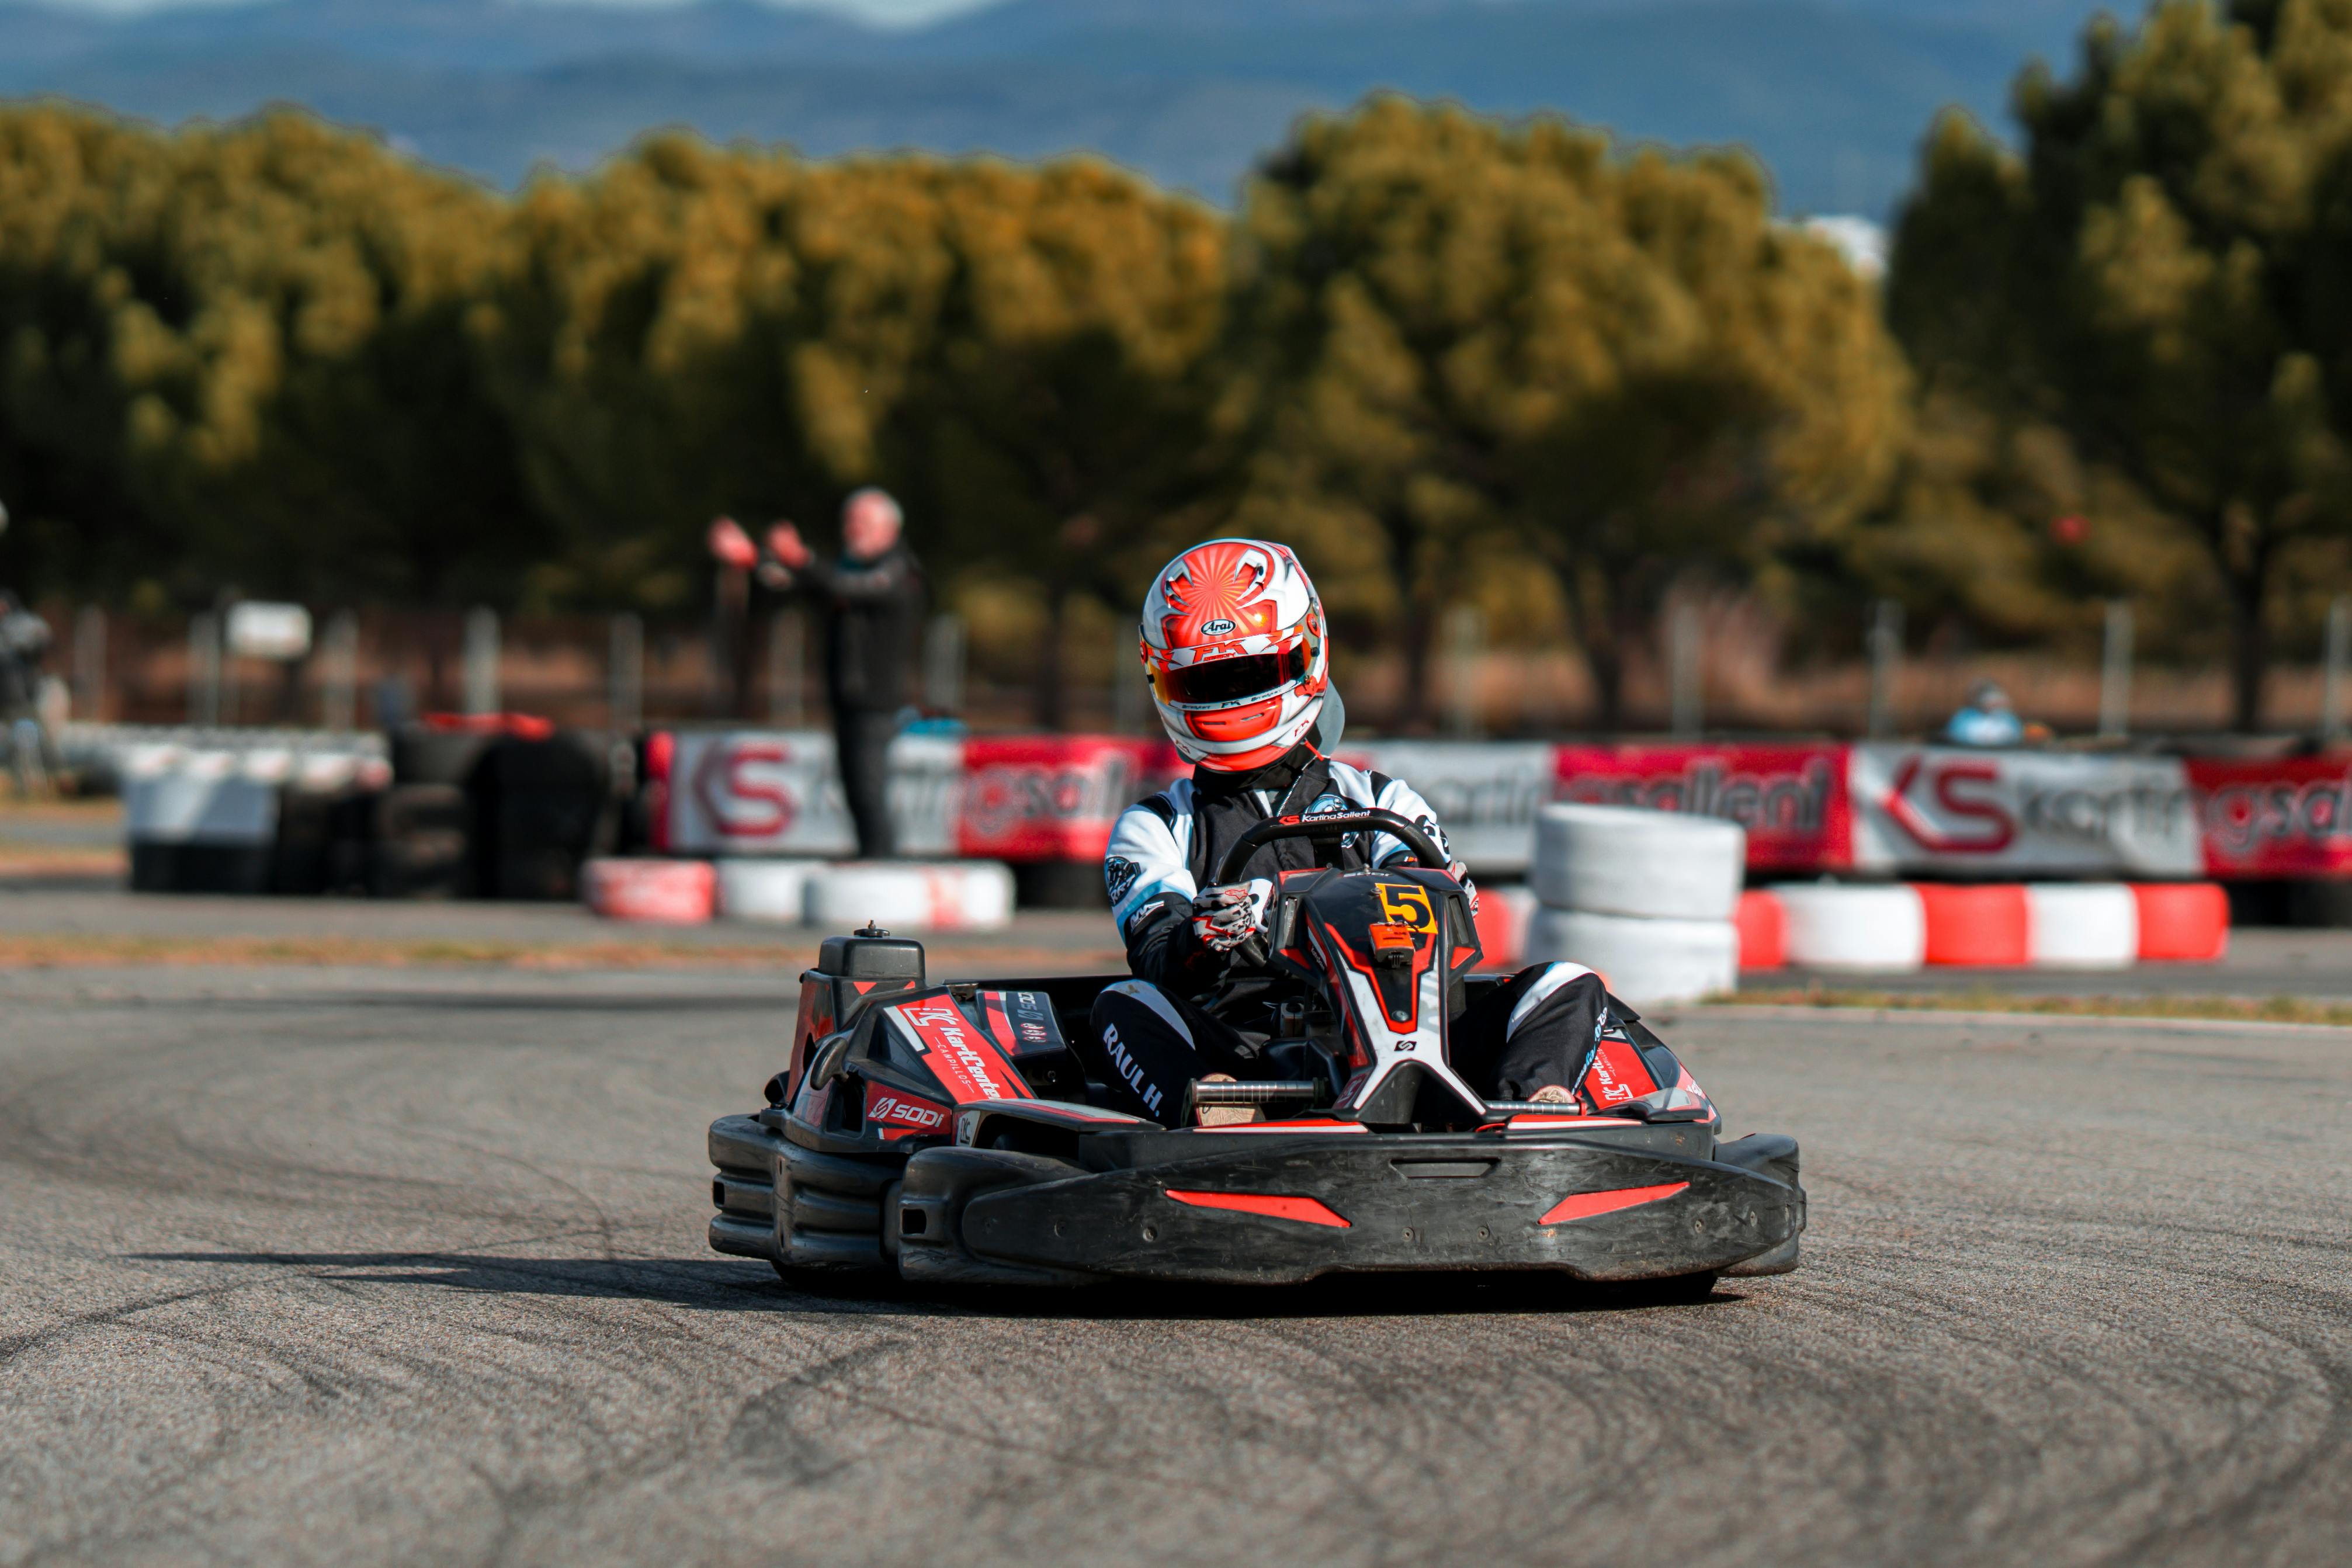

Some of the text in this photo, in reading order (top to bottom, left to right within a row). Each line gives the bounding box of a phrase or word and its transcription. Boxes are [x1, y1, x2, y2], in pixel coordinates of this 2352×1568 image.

[1203, 621, 1231, 632] Arai
[1385, 886, 1425, 929] 5
[937, 1044, 972, 1085] CAMPILLOS
[1103, 1023, 1163, 1117] RAUL H.
